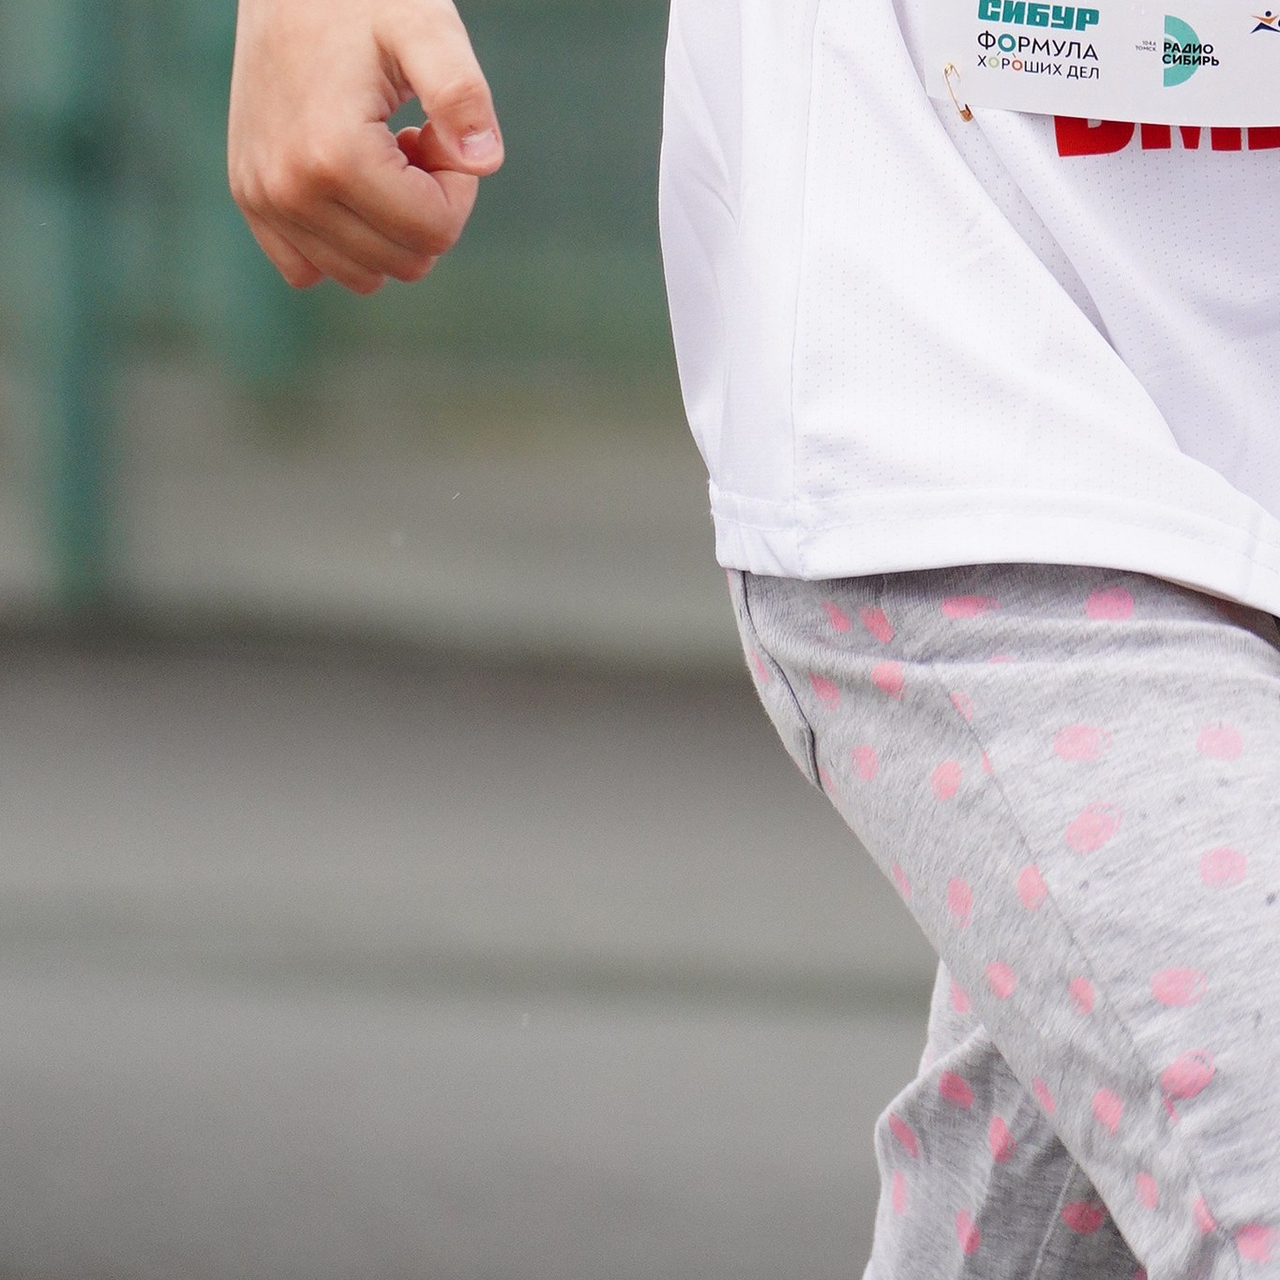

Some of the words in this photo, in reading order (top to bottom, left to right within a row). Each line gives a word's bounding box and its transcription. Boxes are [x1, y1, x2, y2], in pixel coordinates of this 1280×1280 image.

[977, 29, 1099, 61] ФОРМУЛА
[1163, 41, 1214, 55] РАДИО
[977, 54, 1062, 76] ХОРОШИХ
[1066, 64, 1100, 80] ДЕЛ
[1161, 53, 1220, 67] СИБИРЬ
